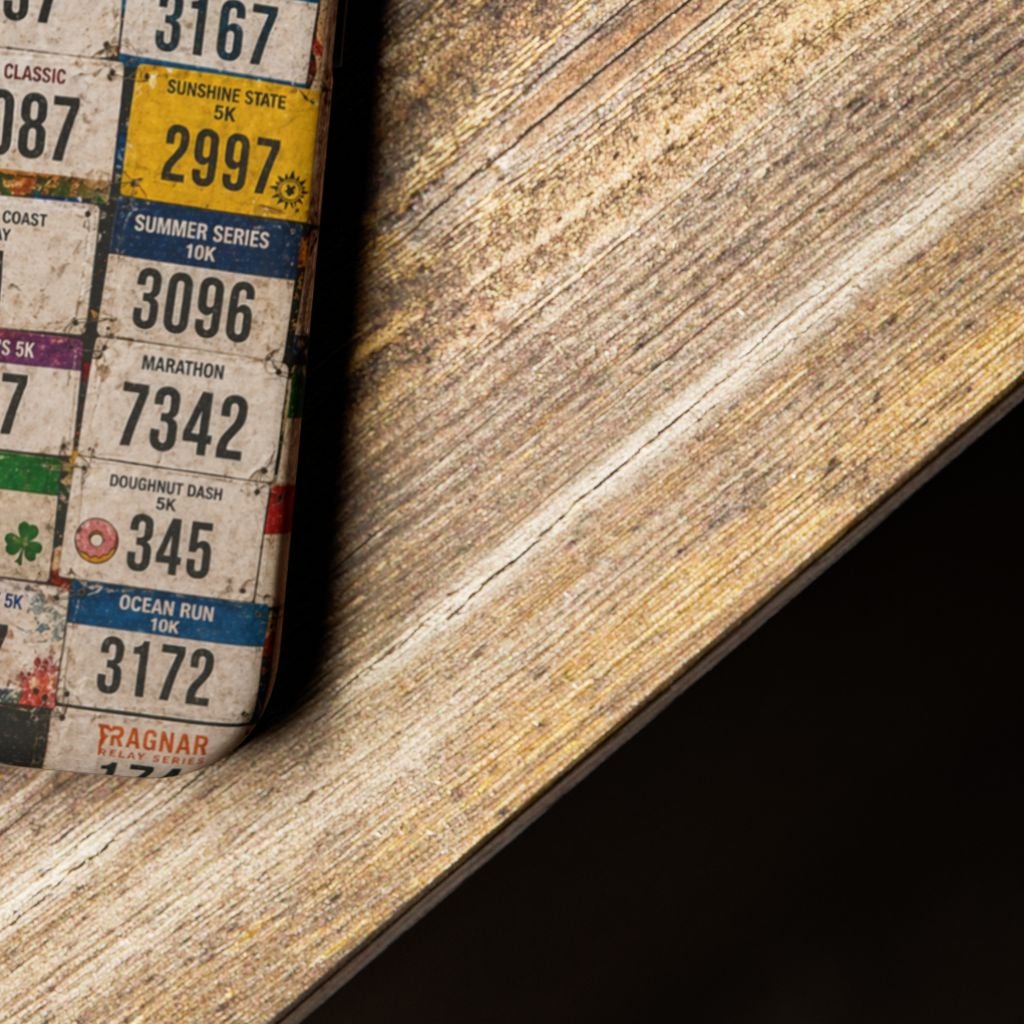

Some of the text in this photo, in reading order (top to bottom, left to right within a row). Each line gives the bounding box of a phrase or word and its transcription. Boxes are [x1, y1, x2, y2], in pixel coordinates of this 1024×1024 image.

[4, 63, 66, 84] CLASSIC
[167, 79, 287, 110] SUNSHINE STATE
[213, 105, 236, 122] 5K
[160, 124, 281, 195] 2997
[2, 210, 48, 227] COAST
[134, 214, 270, 249] SUMMER SERIES
[186, 243, 216, 262] 10K
[132, 267, 255, 343] 3096
[15, 341, 35, 359] 5K
[141, 355, 225, 380] MARATHON
[119, 381, 248, 461] 7342
[109, 474, 223, 501] DOUGHNUT DASH
[155, 497, 176, 512] 5K
[126, 513, 214, 580] 345
[4, 593, 24, 610] 5K
[119, 594, 215, 622] OCEAN RUN
[150, 617, 179, 634] 10K
[96, 636, 215, 707] 3172
[98, 723, 209, 755] RAGNAR
[97, 748, 206, 766] RELAY SERIES
